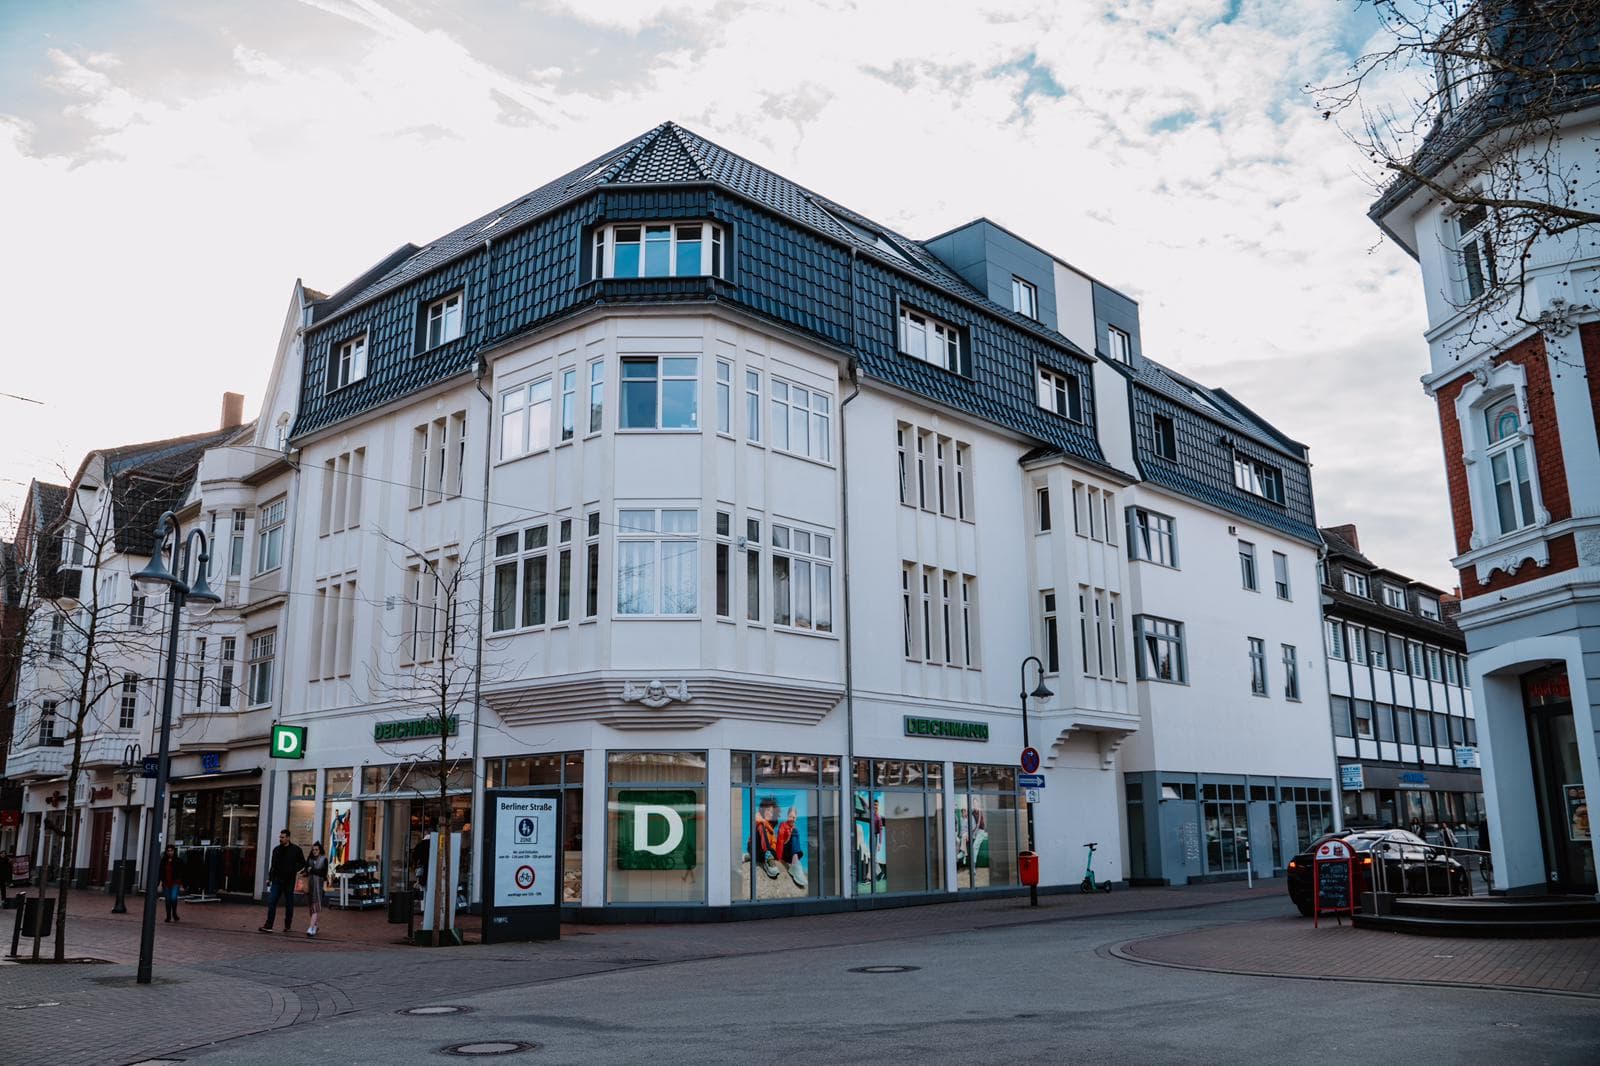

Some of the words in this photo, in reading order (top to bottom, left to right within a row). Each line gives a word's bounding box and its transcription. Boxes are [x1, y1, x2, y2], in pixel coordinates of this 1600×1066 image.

[906, 717, 989, 739] DEICHMANN
[277, 730, 298, 753] D
[501, 802, 529, 811] Berliner
[530, 802, 552, 811] Straße
[634, 804, 684, 855] D
